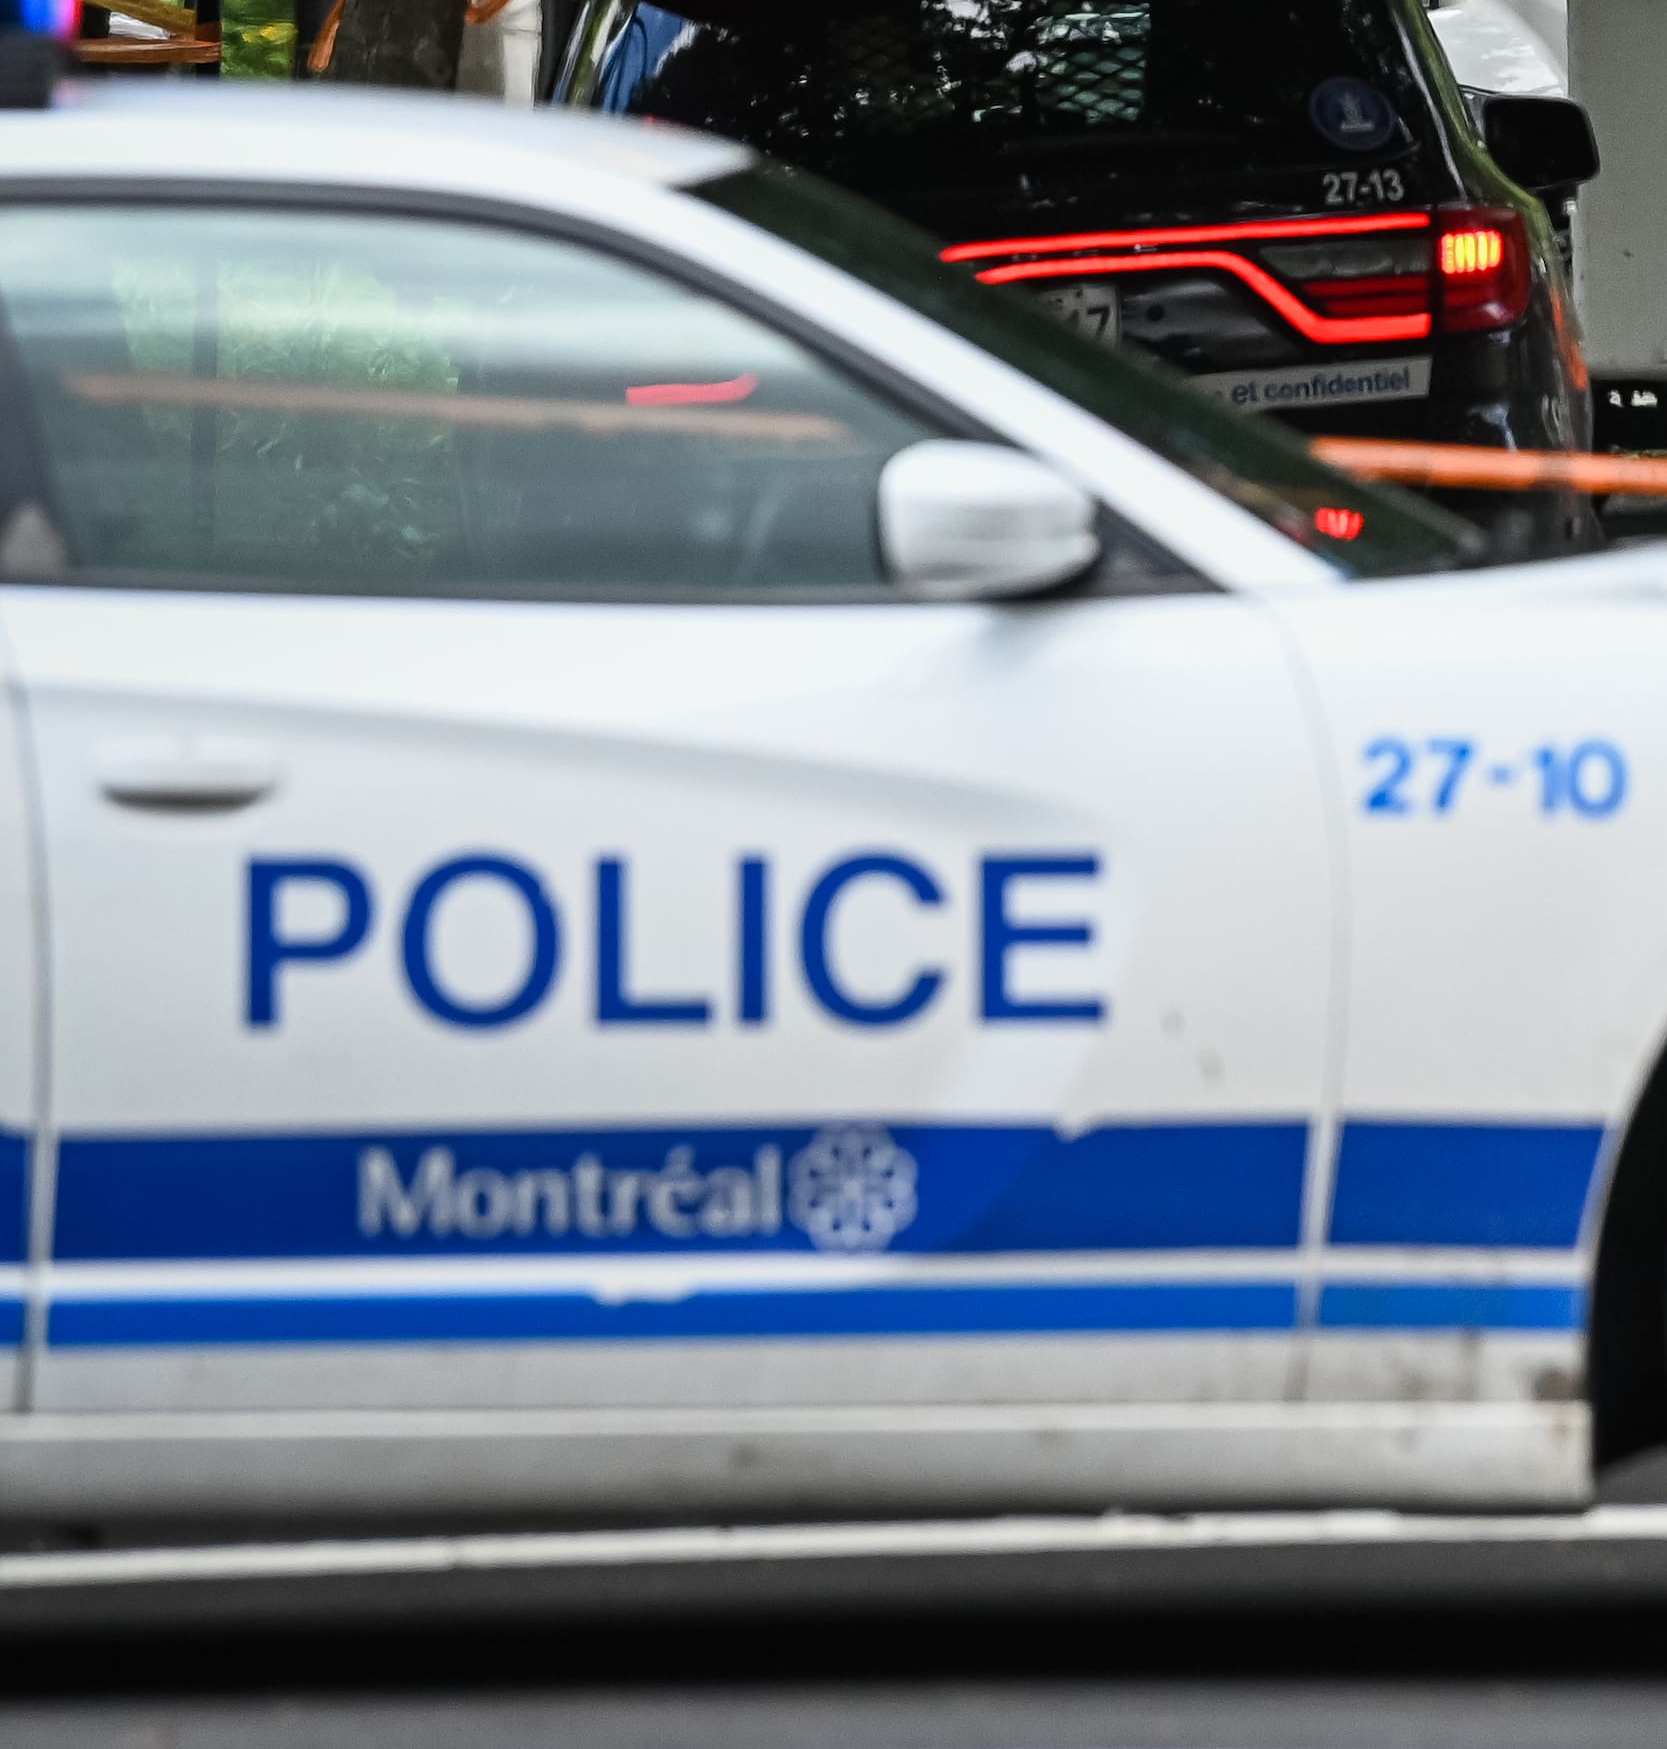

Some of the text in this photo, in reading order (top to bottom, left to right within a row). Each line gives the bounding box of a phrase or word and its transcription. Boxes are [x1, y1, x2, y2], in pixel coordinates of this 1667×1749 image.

[1323, 169, 1404, 205] 27-13
[1264, 366, 1410, 401] confidentiel
[1363, 737, 1630, 820] 27-10
[242, 848, 1107, 1033] POLICE
[360, 1145, 782, 1239] Montréal
